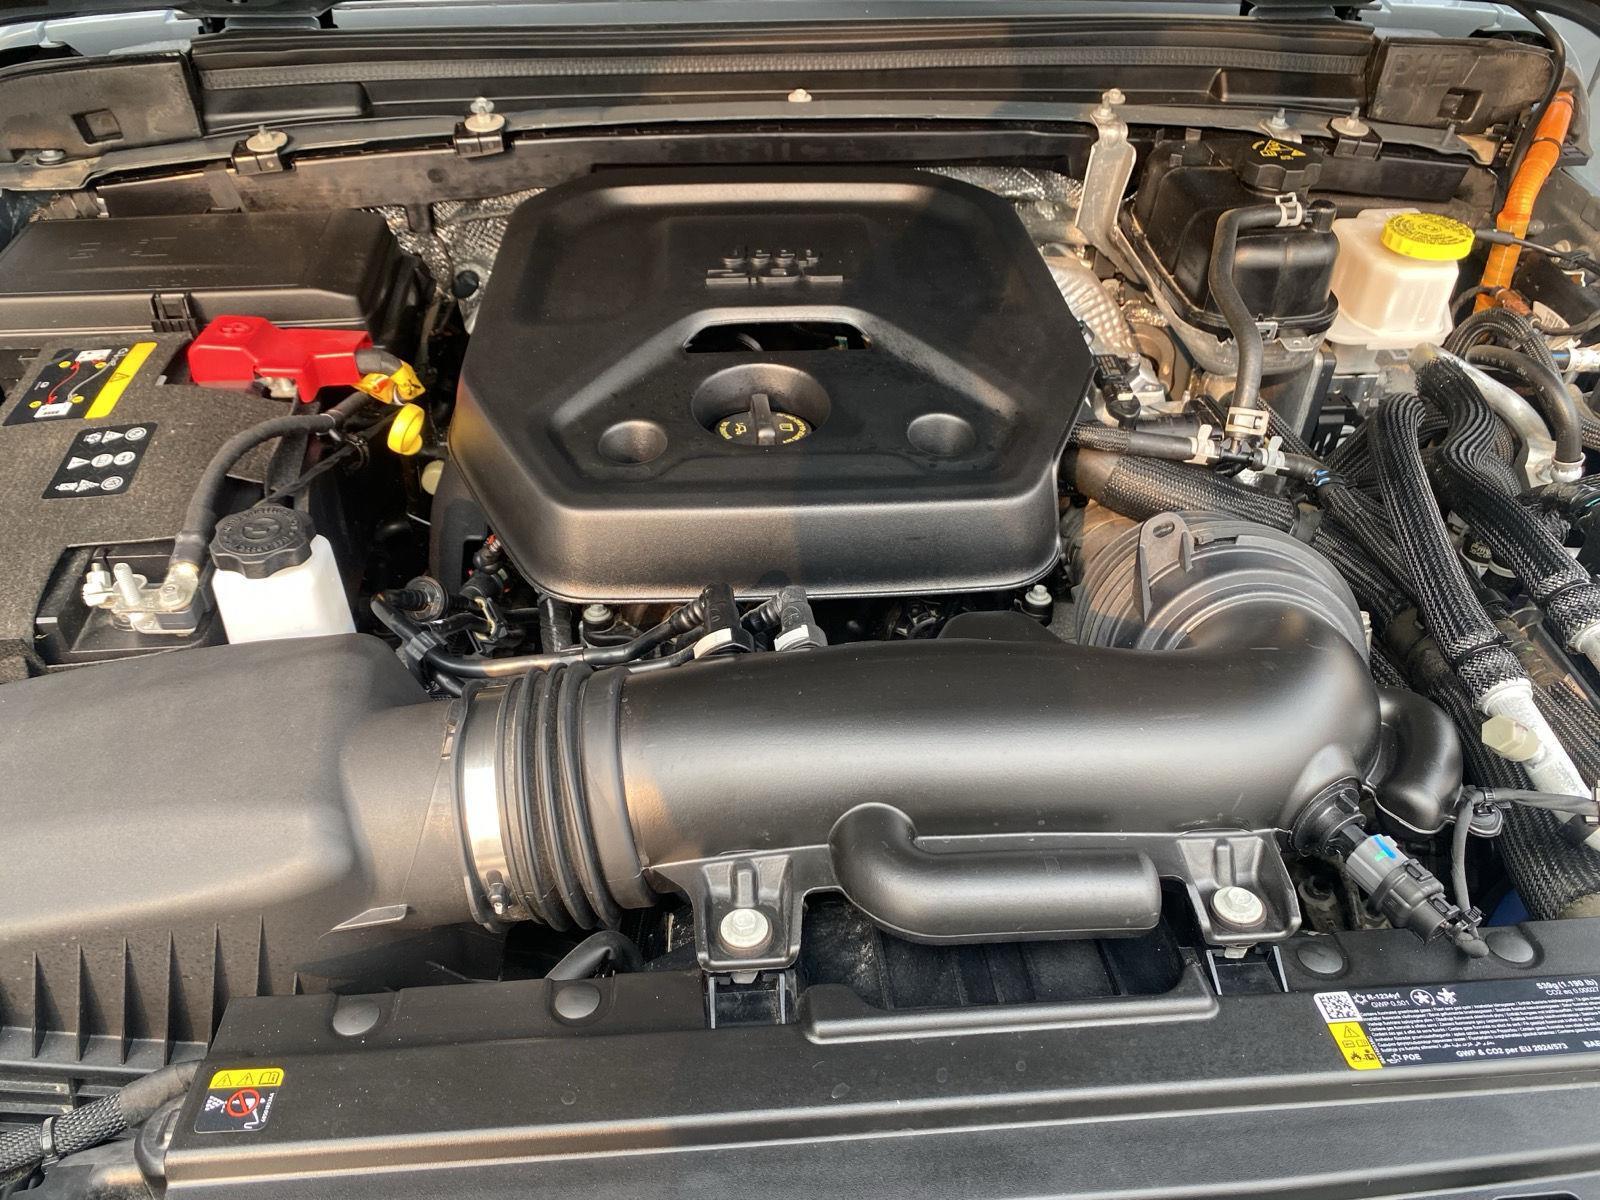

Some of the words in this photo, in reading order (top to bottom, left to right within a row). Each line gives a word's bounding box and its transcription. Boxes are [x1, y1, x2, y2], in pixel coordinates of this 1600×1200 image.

[1456, 1049, 1477, 1058] GWP
[1485, 1046, 1505, 1056] CO2
[1504, 1047, 1519, 1055] per
[1519, 1044, 1533, 1053] EU
[1402, 1053, 1422, 1061] POE
